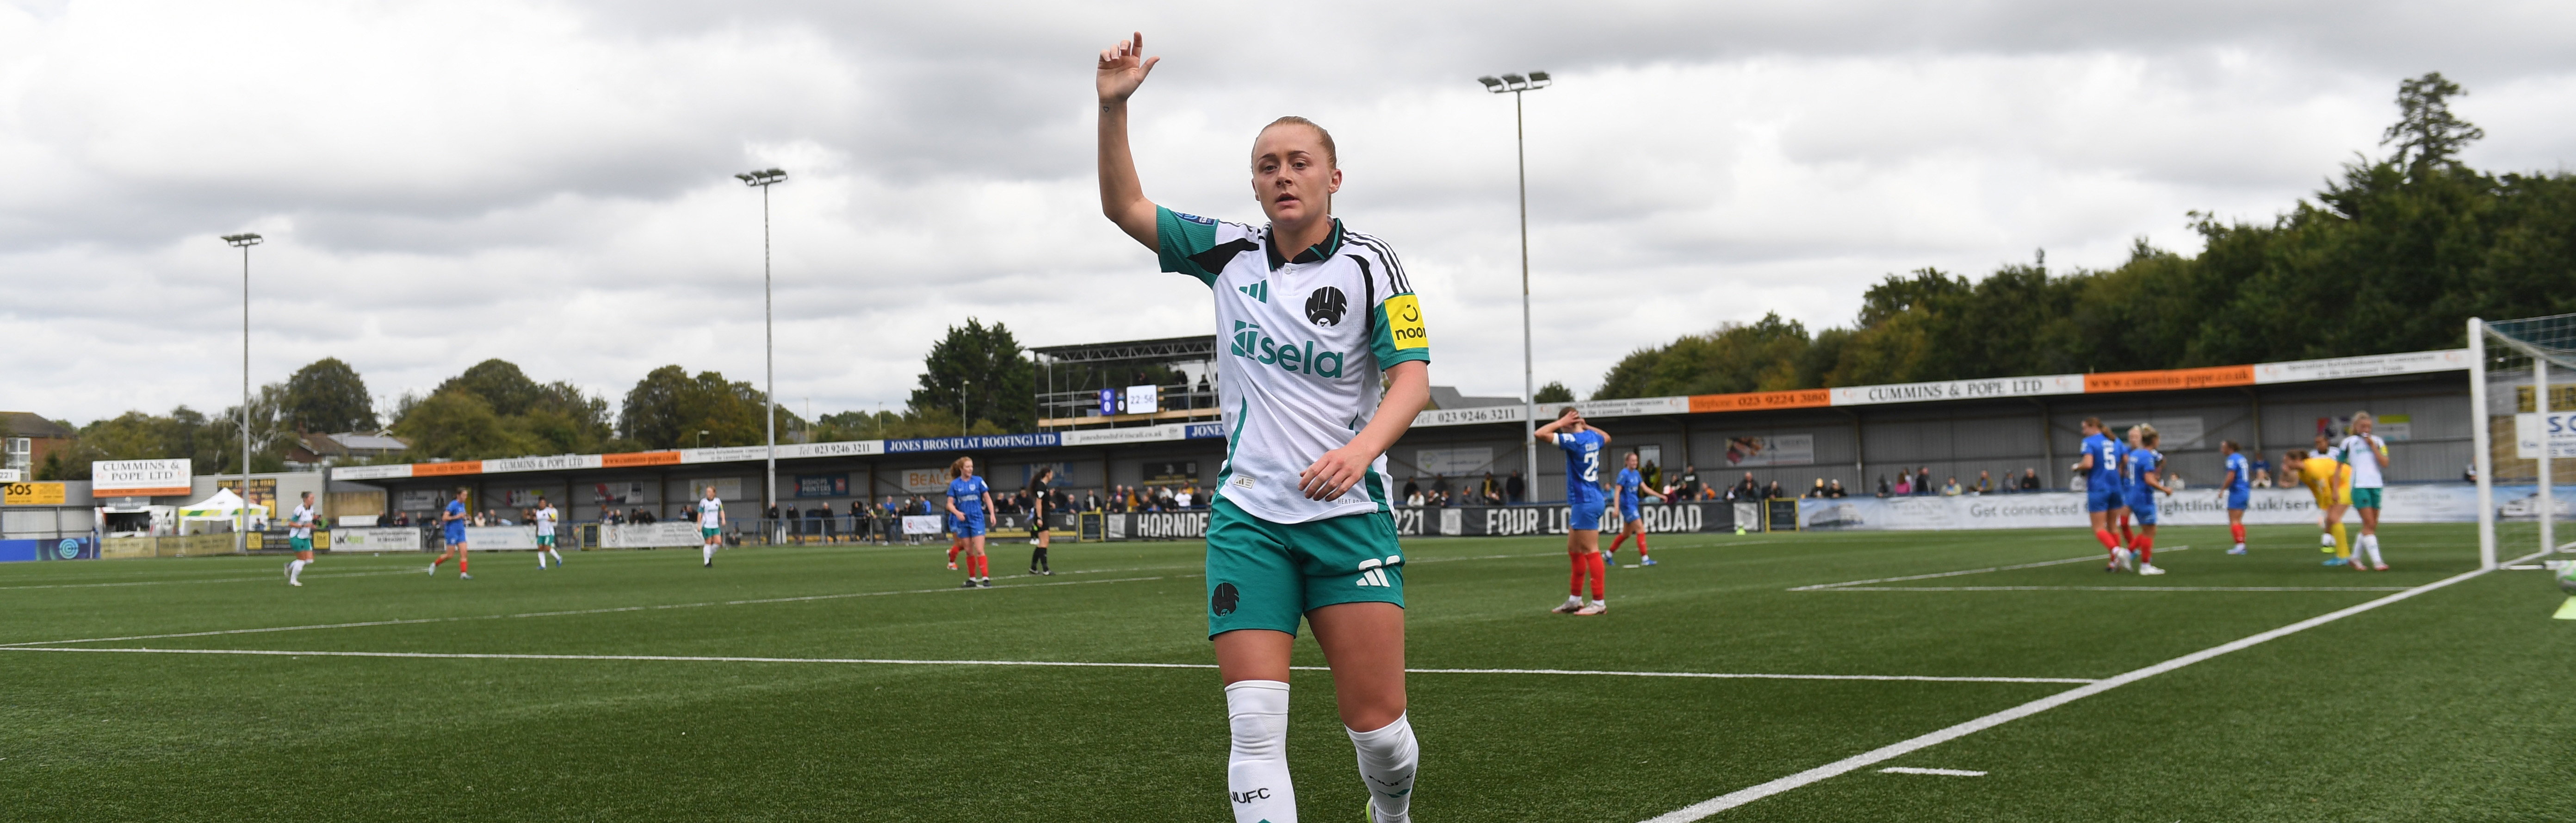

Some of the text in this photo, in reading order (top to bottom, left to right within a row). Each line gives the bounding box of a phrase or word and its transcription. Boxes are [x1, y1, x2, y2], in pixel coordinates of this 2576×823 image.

[1257, 337, 1343, 379] sela
[1868, 378, 2043, 401] CUMMINS & POPE LTD
[1738, 398, 1760, 406] 023
[1437, 412, 1457, 423] 023
[1460, 410, 1487, 421] 9246
[1490, 408, 1515, 420] 3211
[1192, 424, 1224, 437] JONES
[815, 445, 829, 455] 023
[831, 444, 850, 454] 9246
[853, 443, 870, 453] 3211
[890, 433, 1056, 452] JONES BROS (FLAT ROOFING) LTD
[103, 460, 179, 471] CUMMINS &
[500, 456, 583, 471] CUMMINS & POPE LTD
[2103, 447, 2117, 471] 5
[111, 470, 173, 481] POPE LTD
[7, 484, 31, 495] SOS
[1970, 503, 2078, 518] Get connected
[1137, 508, 1424, 537] HORNDE 221
[1486, 505, 1703, 536] FOUR LOO ROAD
[1230, 787, 1271, 804] NUFC
